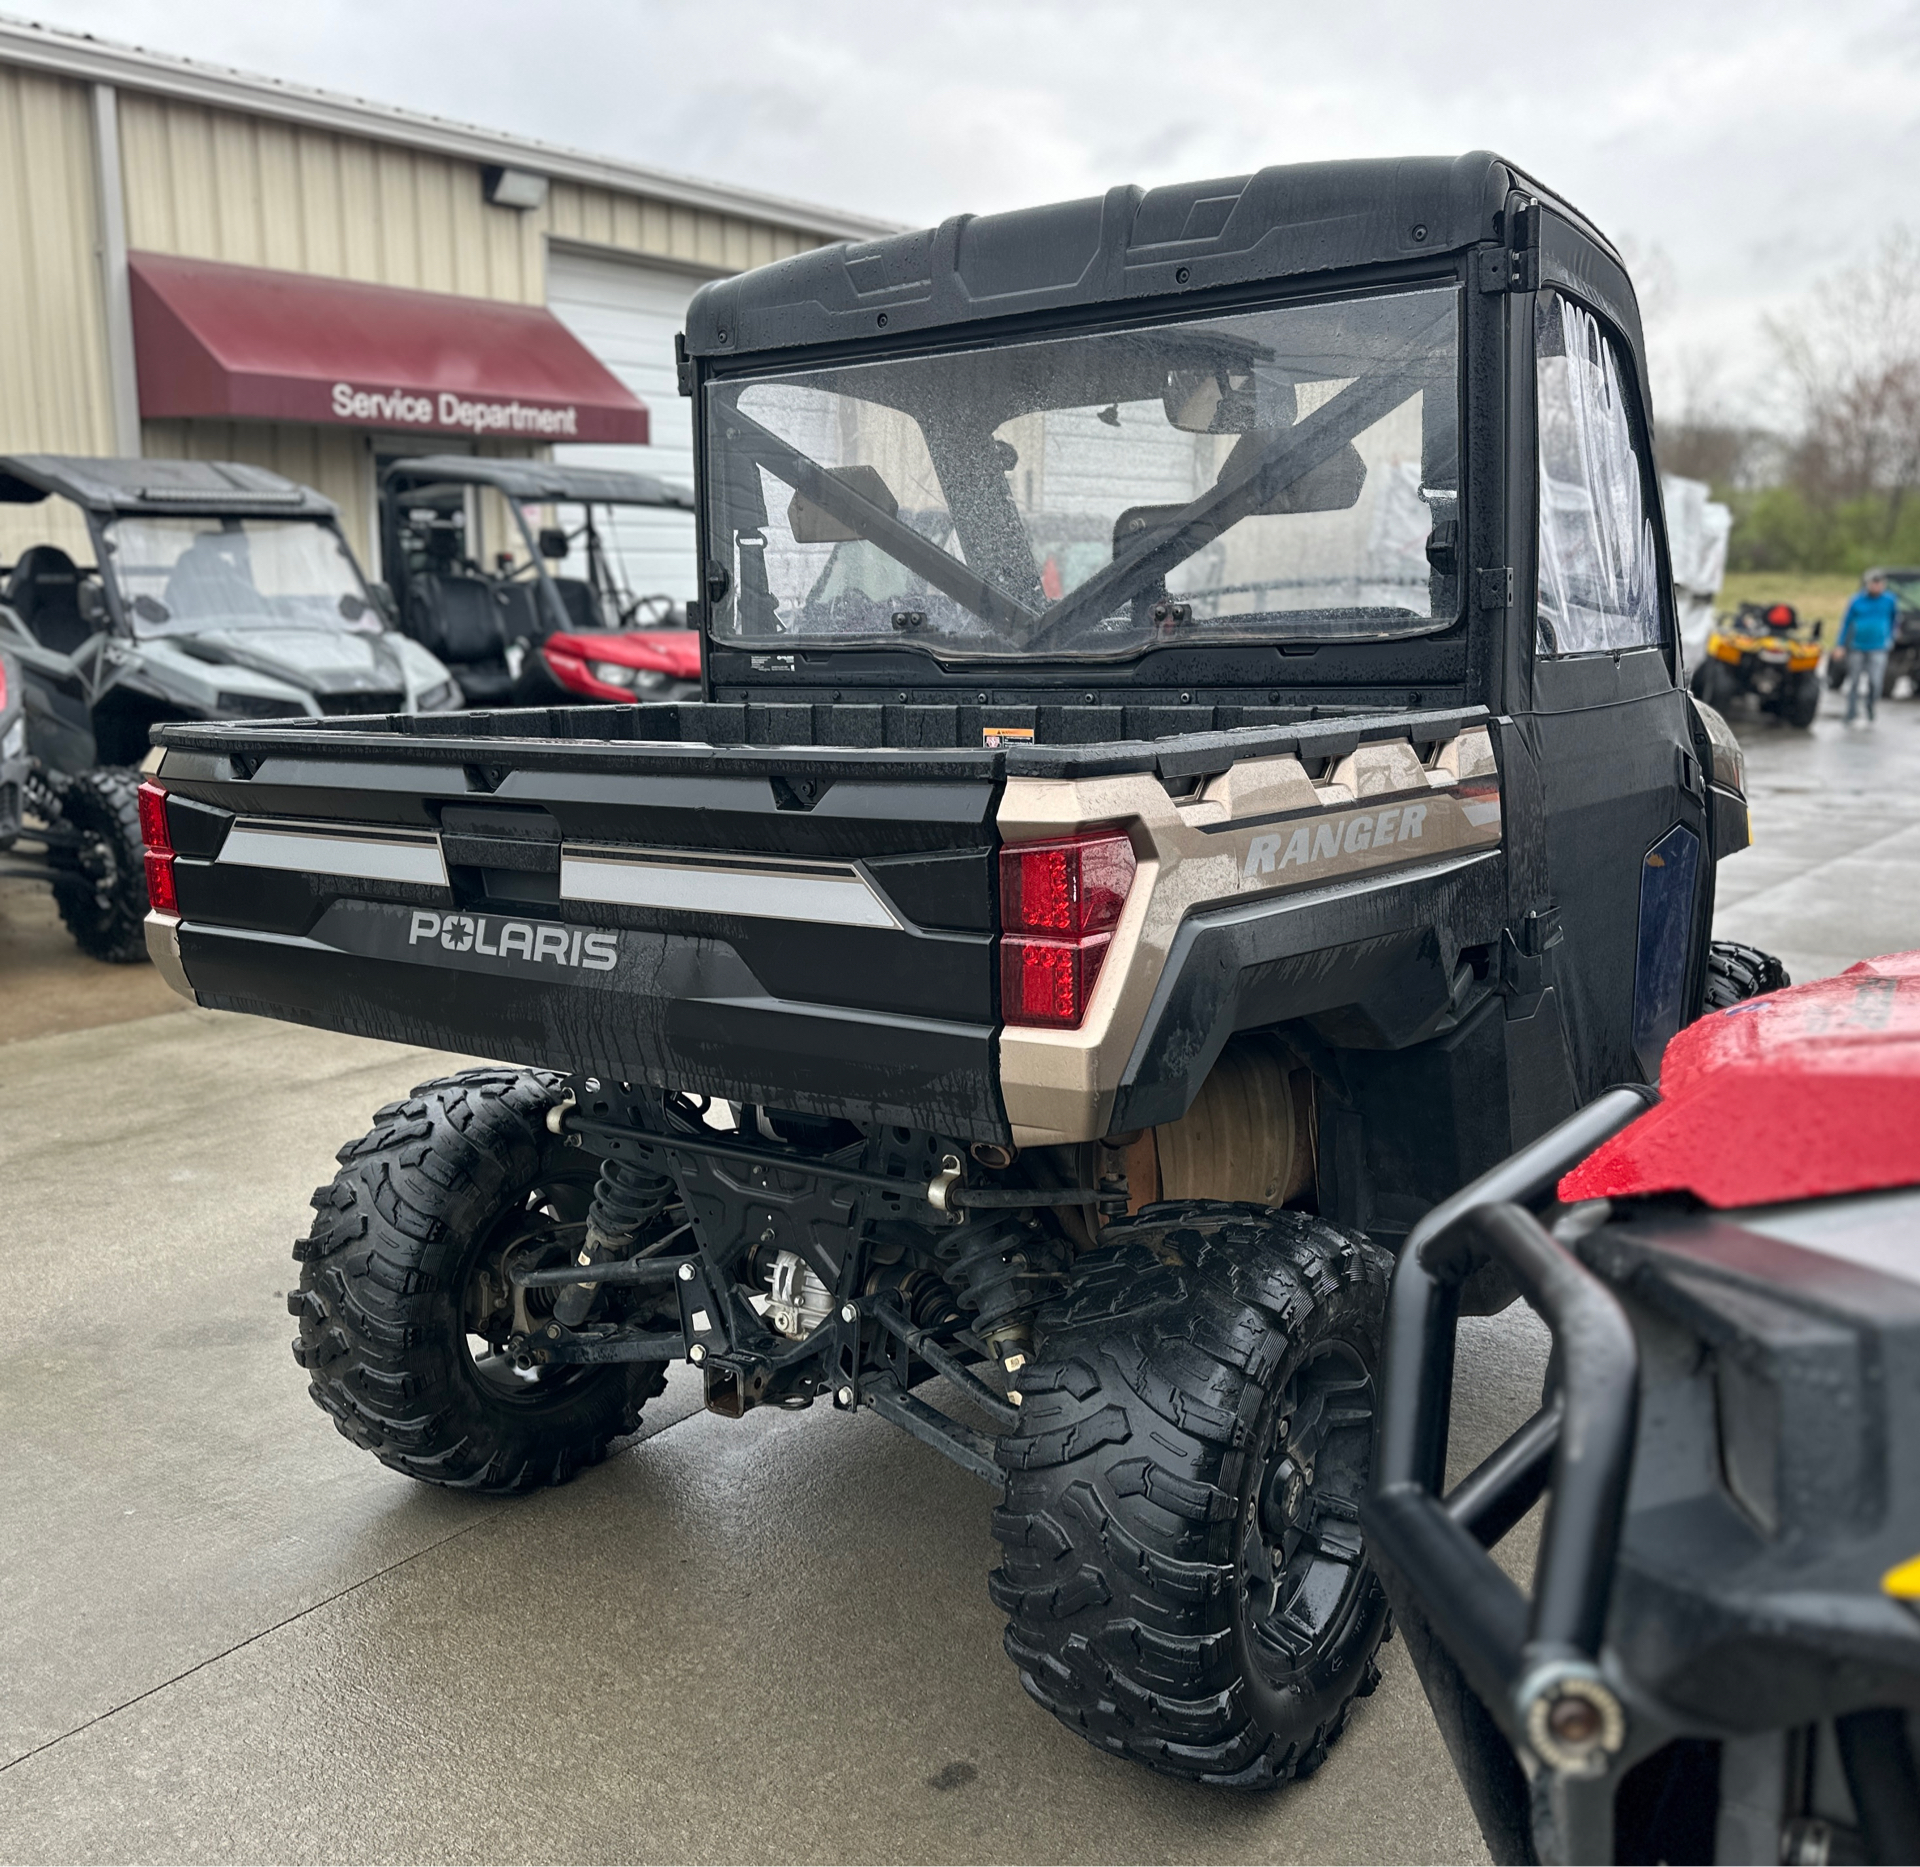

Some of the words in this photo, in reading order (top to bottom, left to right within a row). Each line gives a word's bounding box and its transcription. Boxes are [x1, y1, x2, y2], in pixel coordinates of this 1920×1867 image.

[332, 383, 432, 422] Service
[438, 393, 577, 434] Department
[1243, 804, 1427, 877] RANGER
[409, 911, 618, 971] POLARIS
